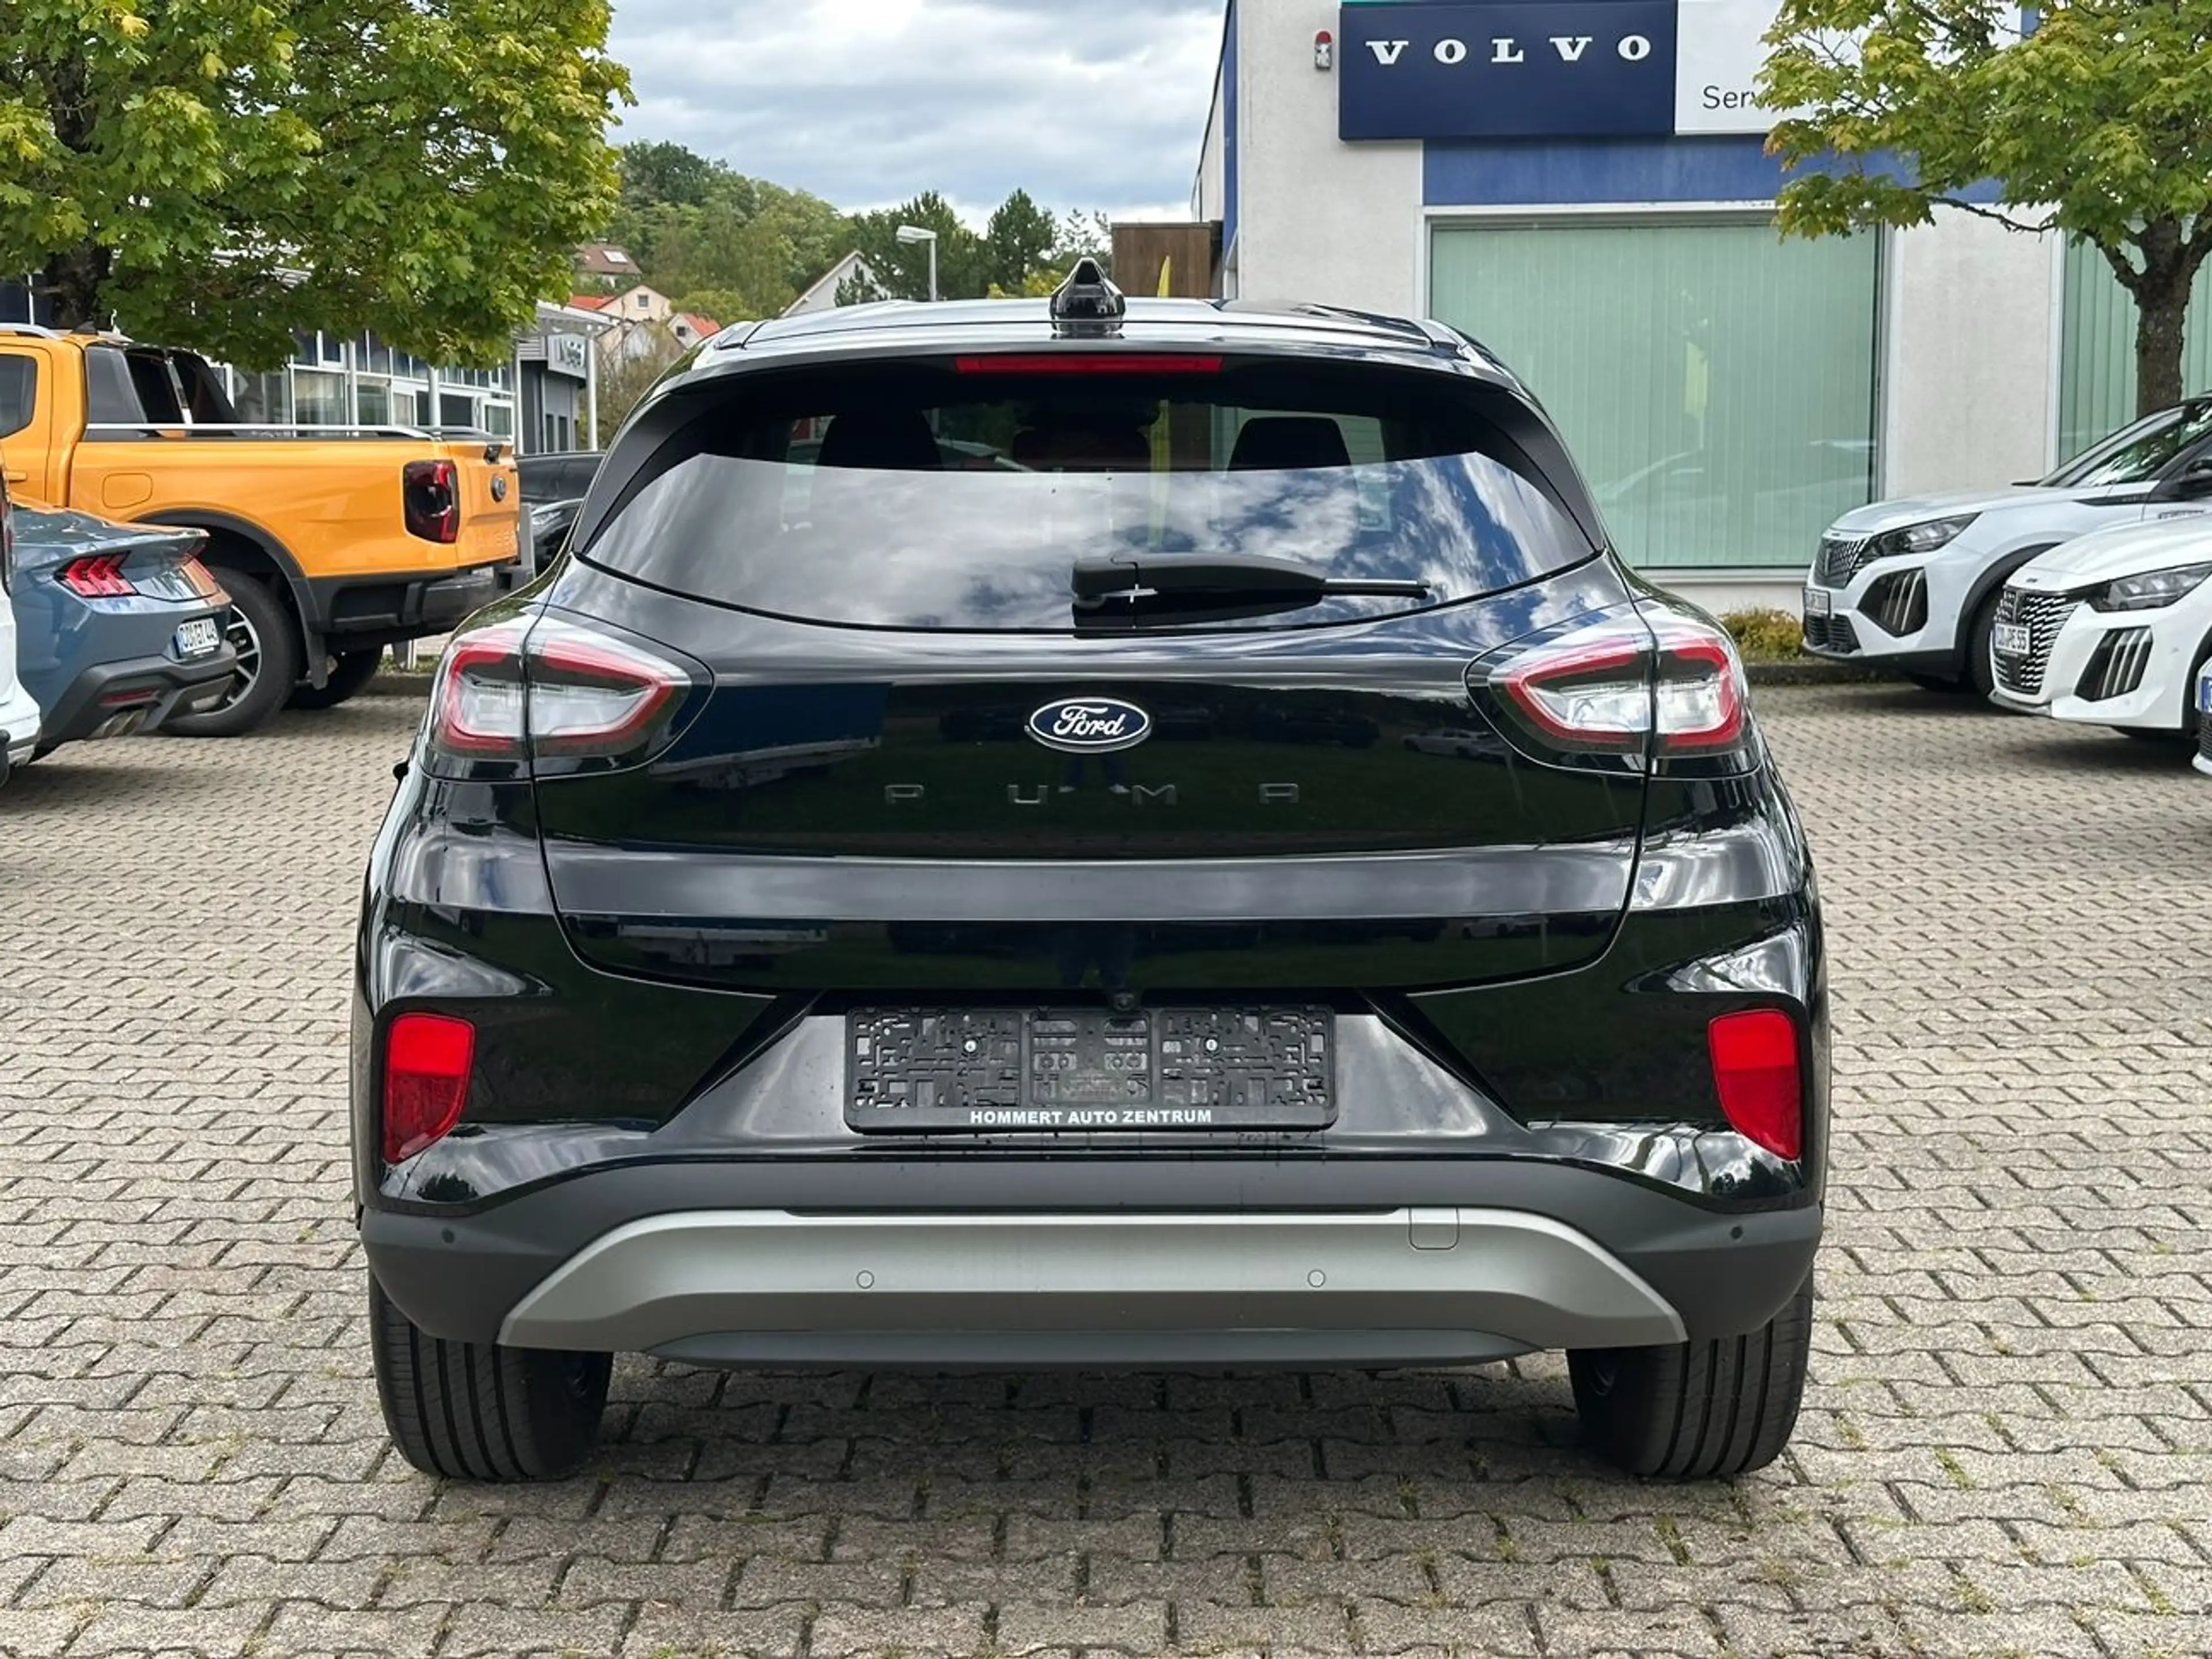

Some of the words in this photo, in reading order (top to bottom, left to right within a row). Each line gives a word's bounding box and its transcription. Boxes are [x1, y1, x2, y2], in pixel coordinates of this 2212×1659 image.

[1366, 35, 1651, 65] VOLVO
[1052, 705, 1126, 736] Ford
[885, 783, 1300, 805] PUMA
[969, 1111, 1062, 1124] HOMMERT
[1067, 1111, 1117, 1124] AUTO
[1122, 1109, 1211, 1123] ZENTRUM
